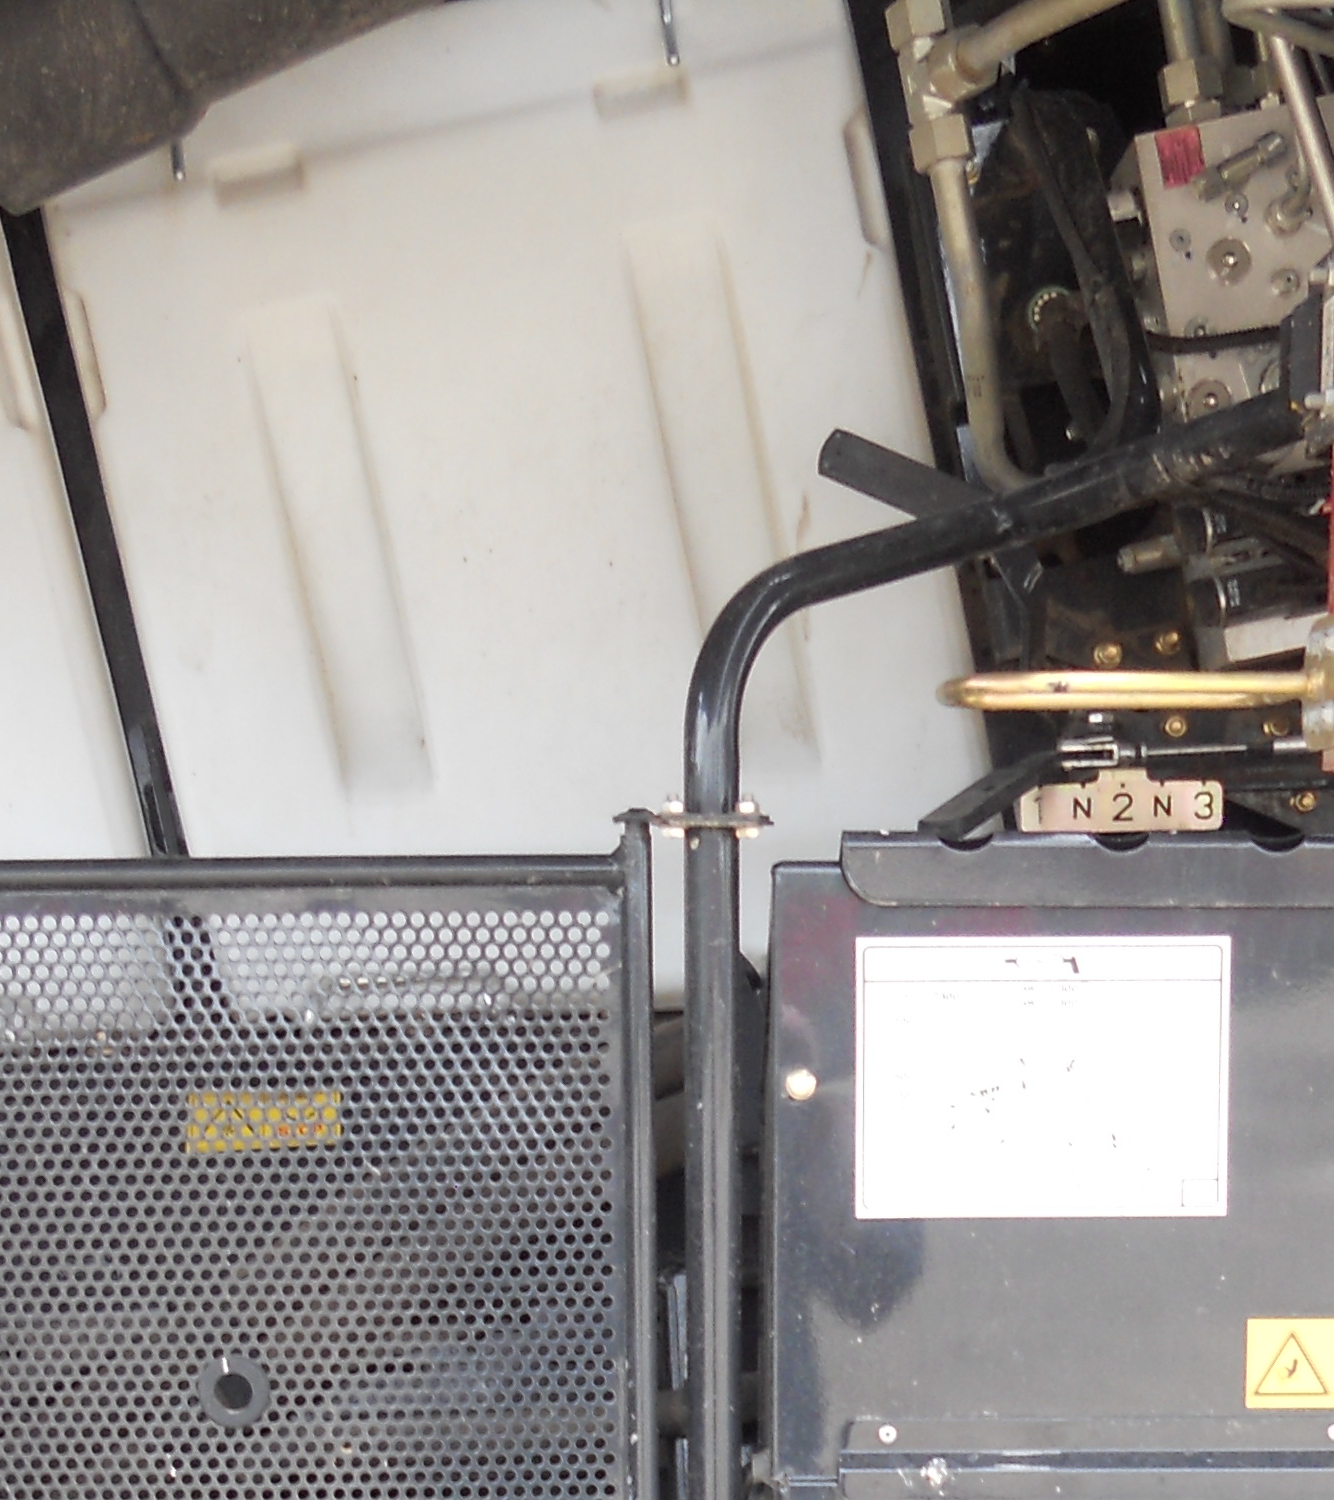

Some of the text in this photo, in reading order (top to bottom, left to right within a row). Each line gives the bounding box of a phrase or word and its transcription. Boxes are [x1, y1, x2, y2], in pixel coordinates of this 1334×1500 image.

[1033, 791, 1214, 825] 1 N 2 N 3
